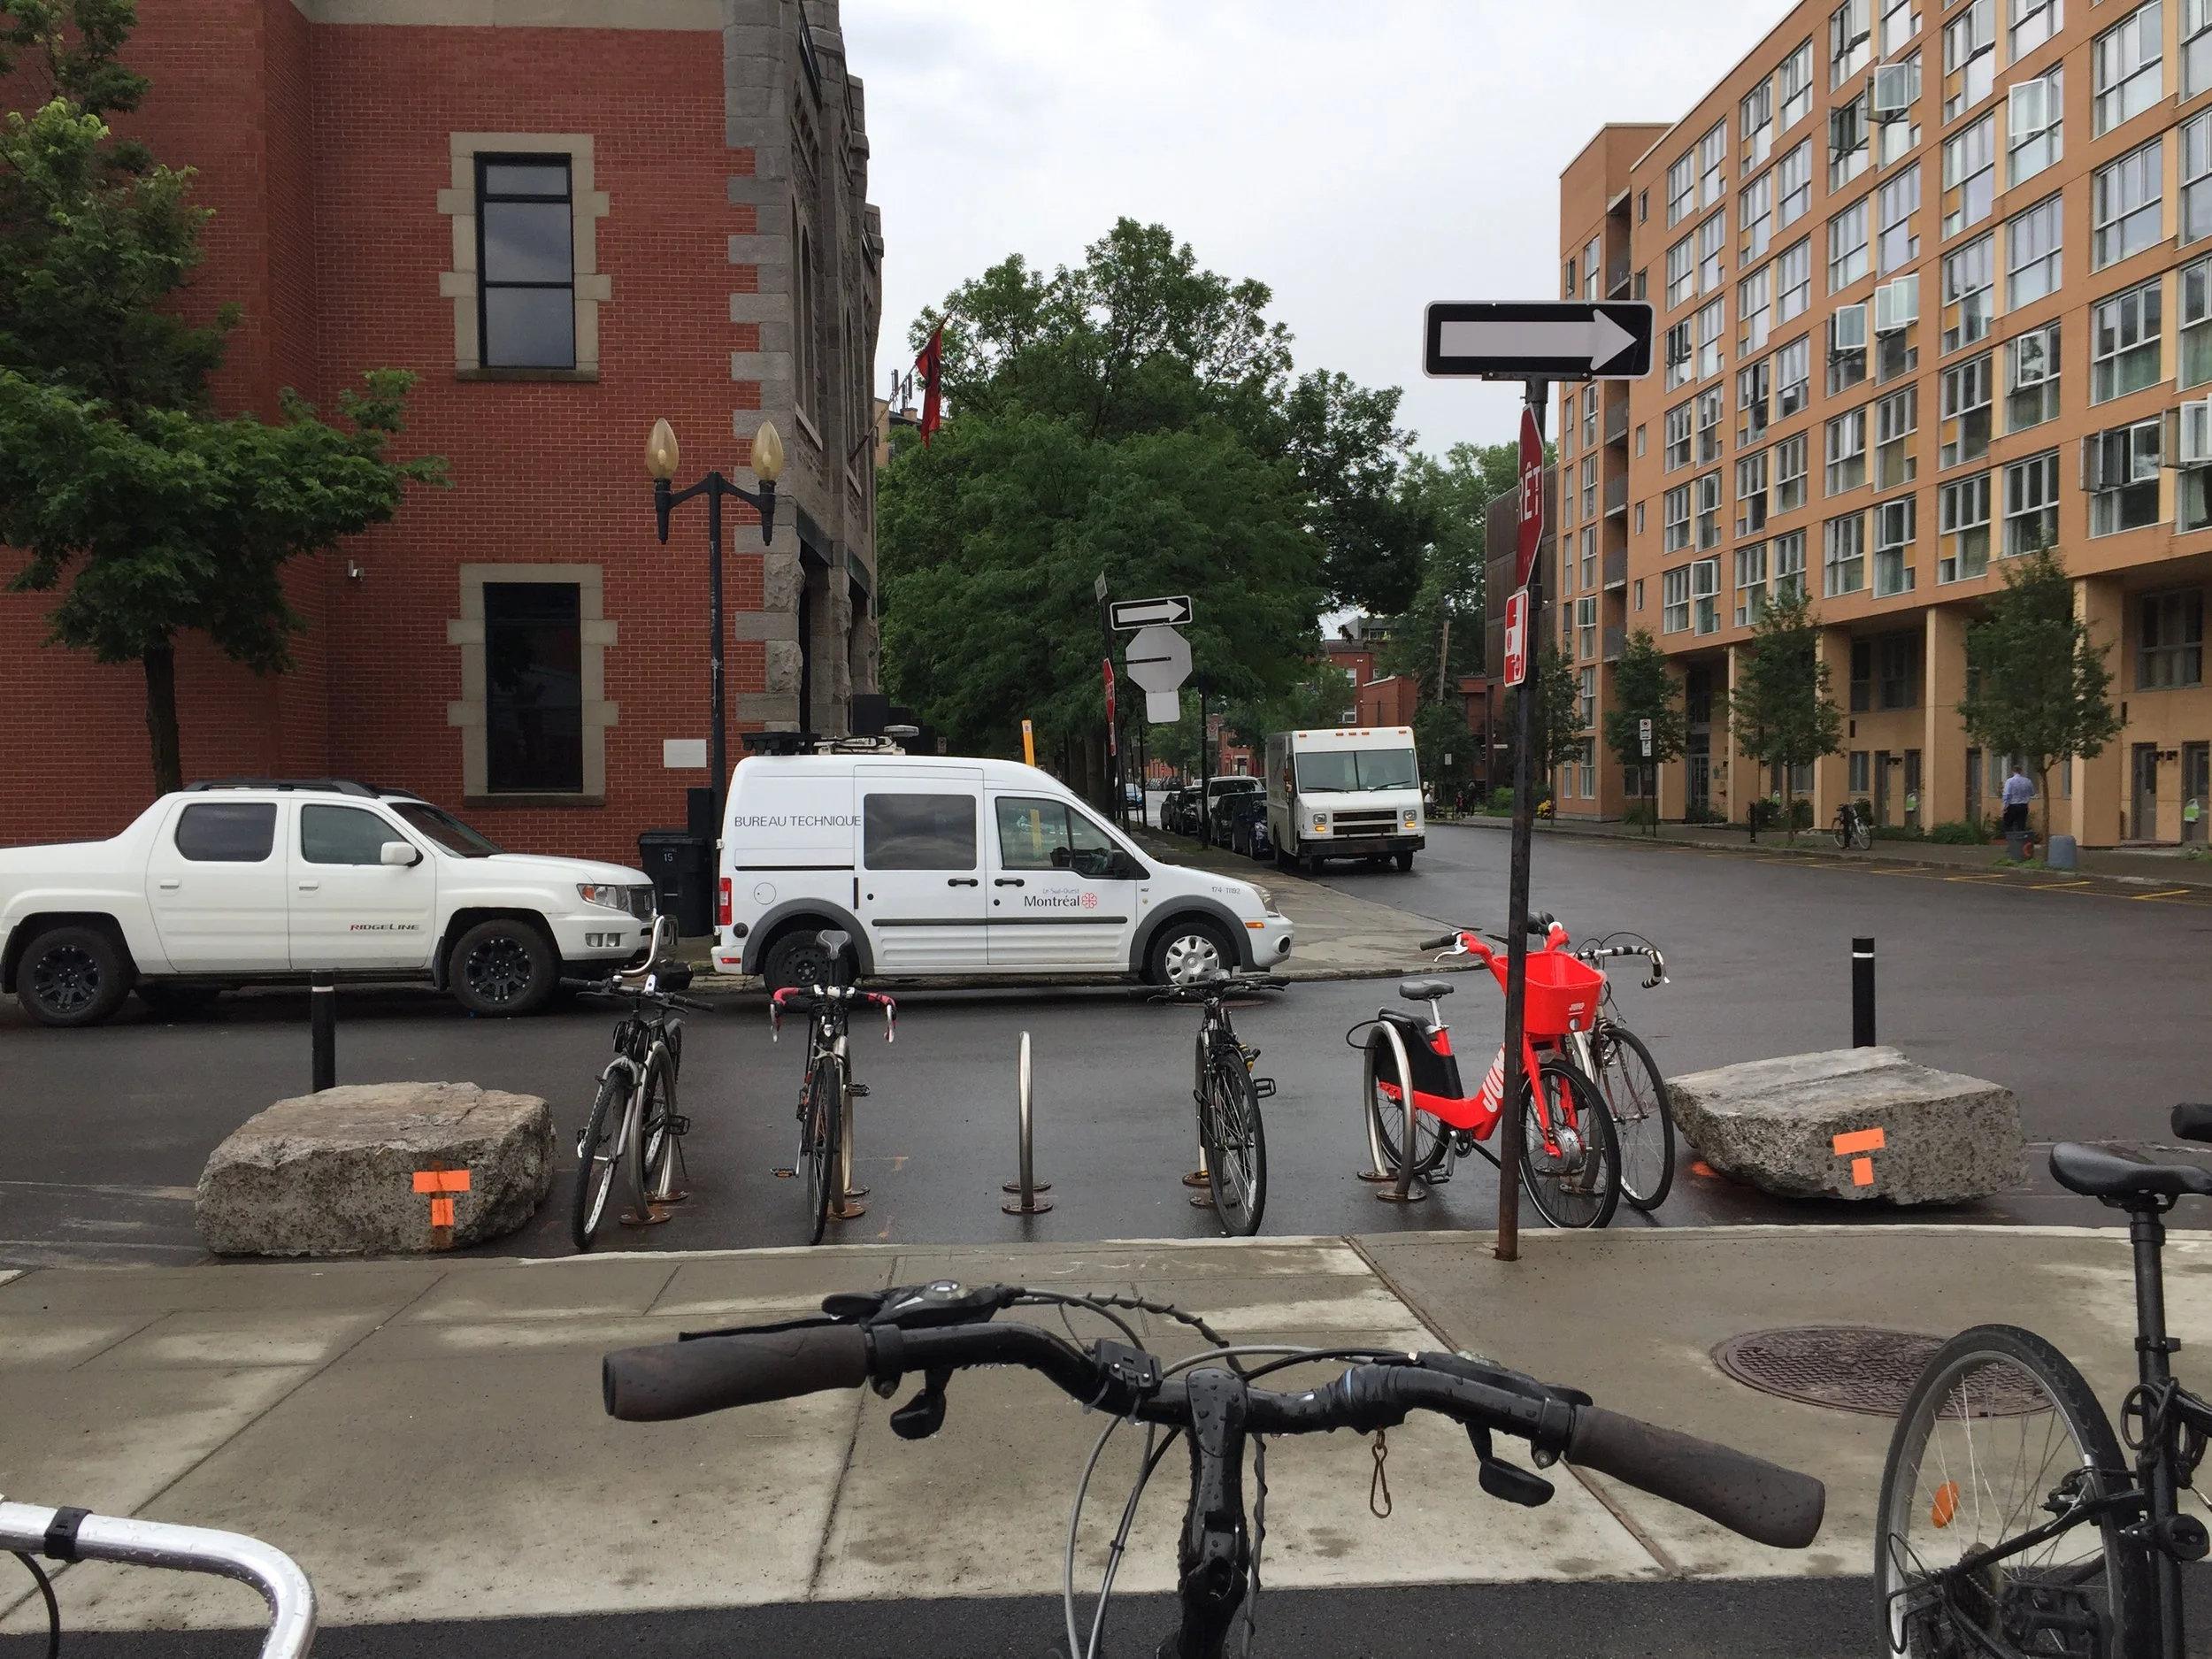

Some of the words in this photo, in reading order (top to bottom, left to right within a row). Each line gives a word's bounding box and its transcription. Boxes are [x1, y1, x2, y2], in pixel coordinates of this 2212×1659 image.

[733, 816, 787, 826] BUREAU
[789, 815, 862, 826] TECHNIQUE
[664, 852, 673, 862] 15
[1024, 895, 1080, 907] Montréal
[1481, 1041, 1505, 1113] JUM
